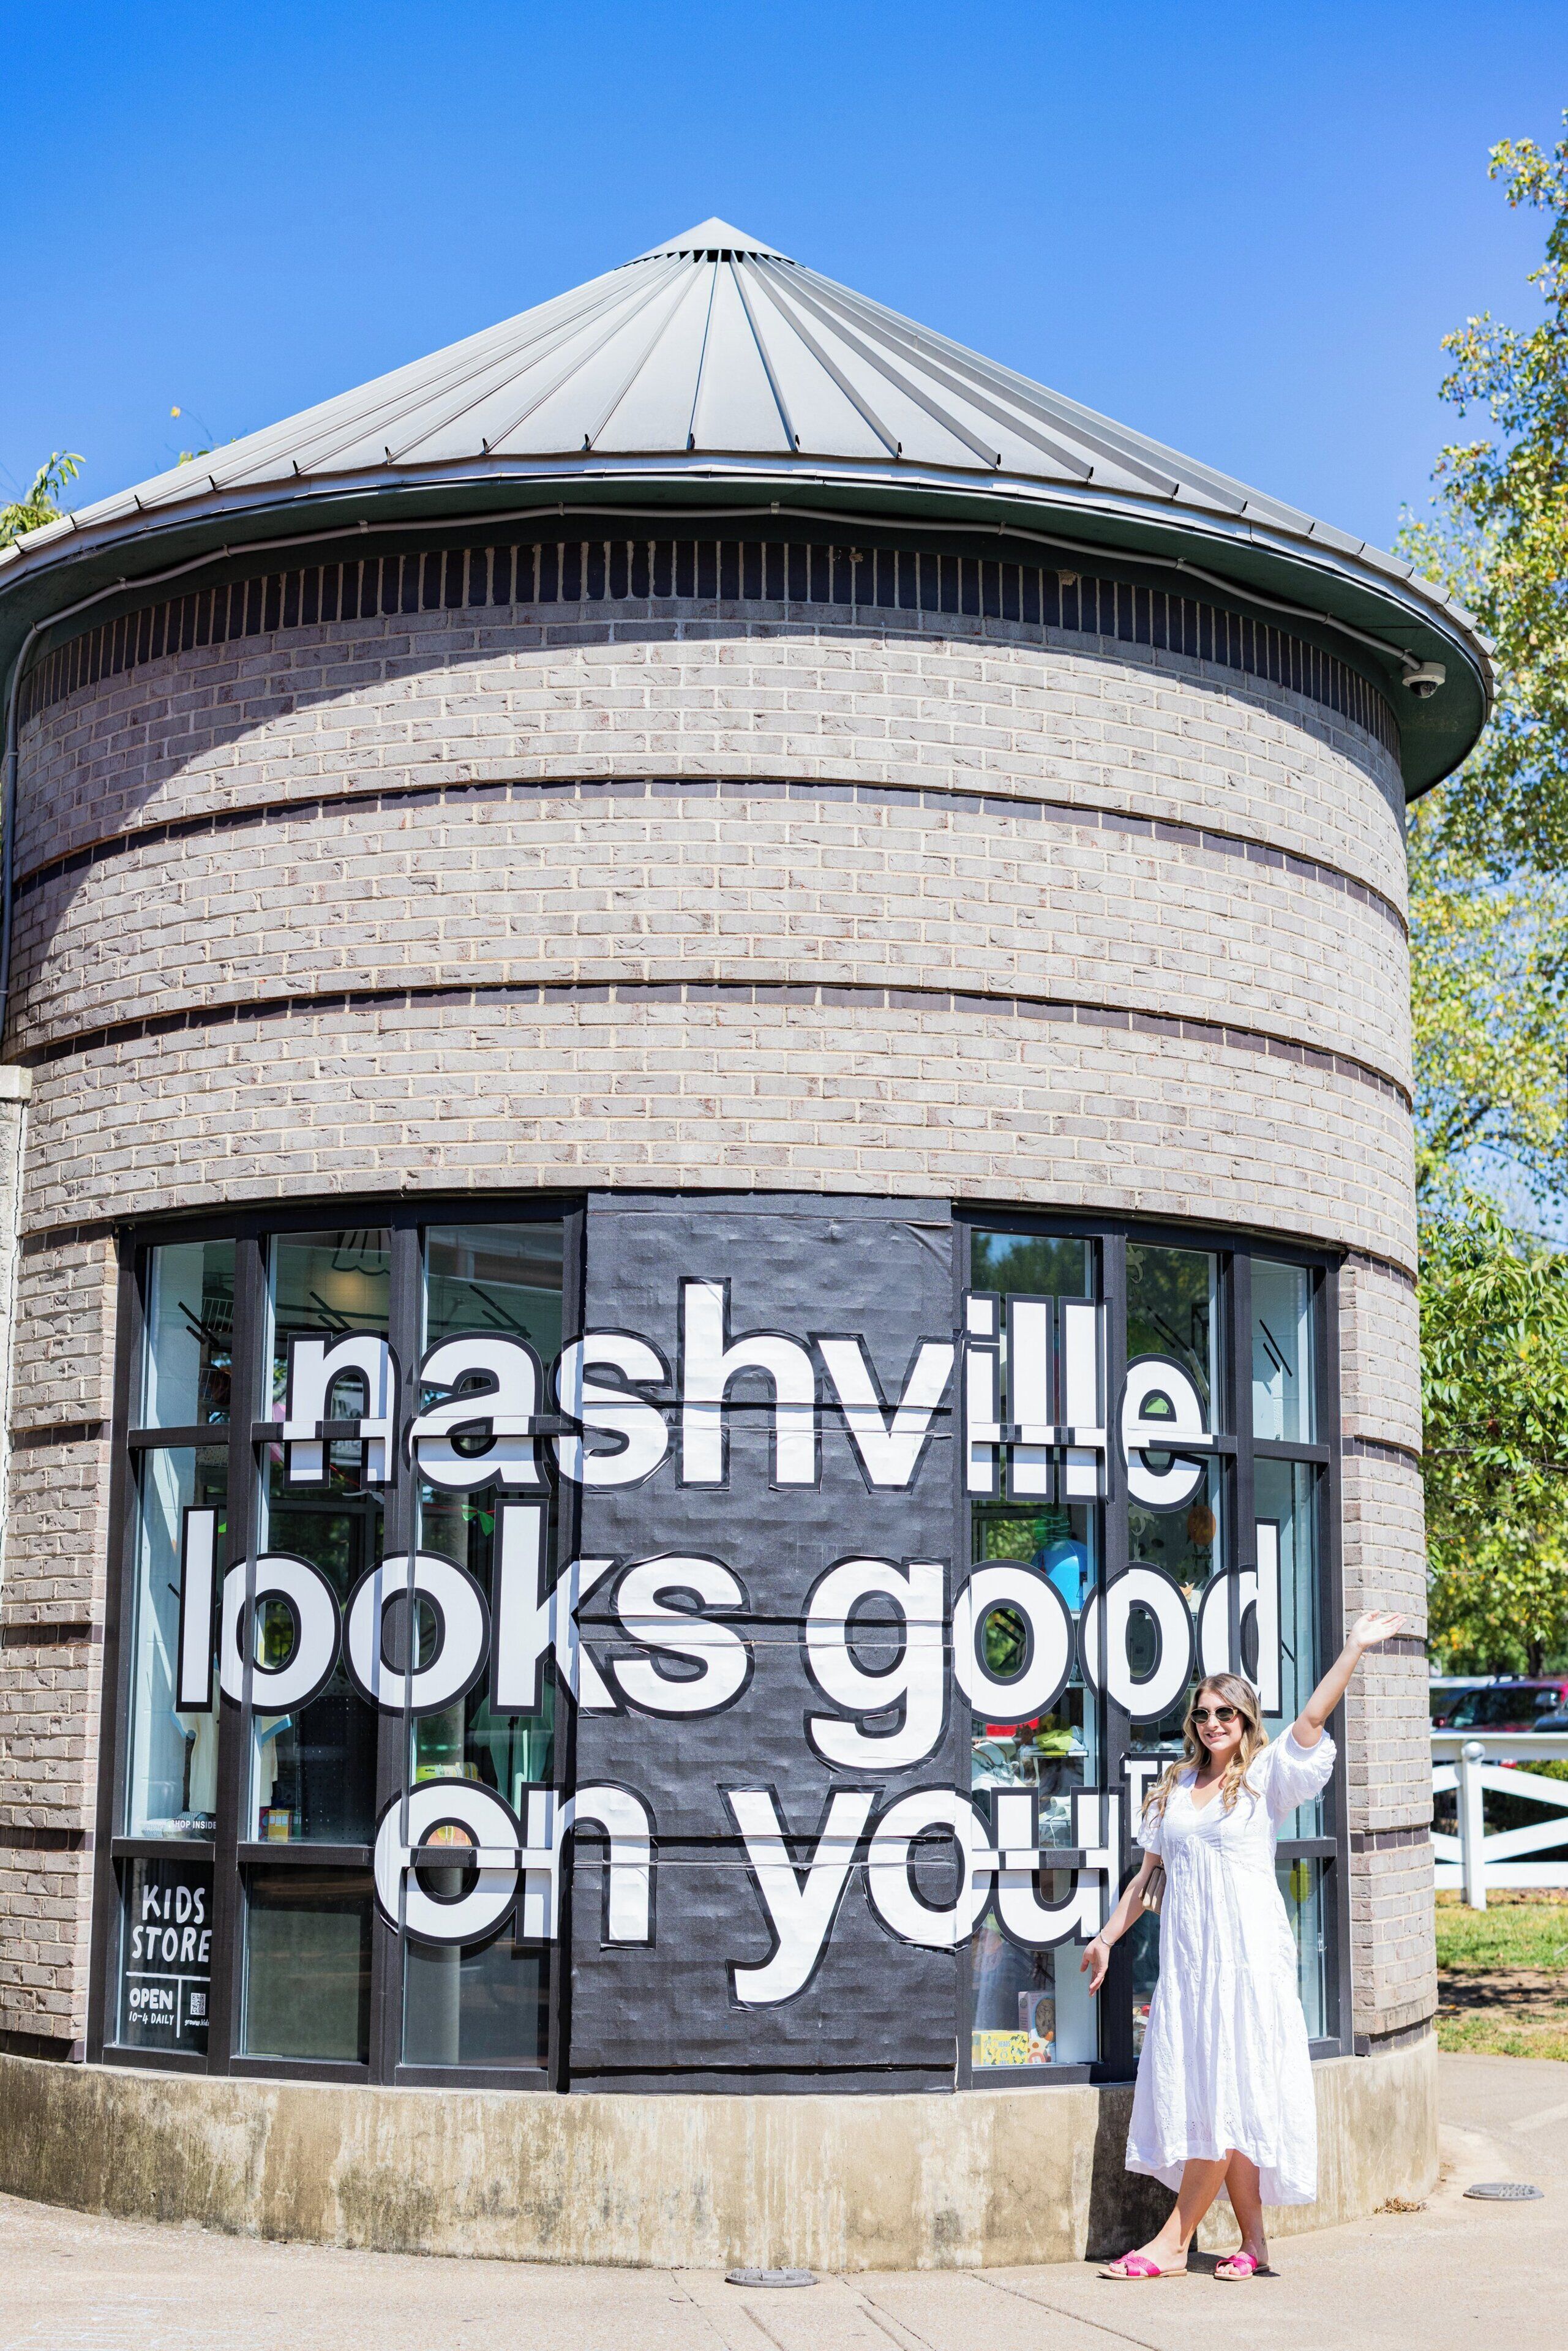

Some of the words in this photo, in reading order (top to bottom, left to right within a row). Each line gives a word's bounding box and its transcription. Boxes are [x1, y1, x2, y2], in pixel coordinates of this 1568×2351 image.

[282, 1283, 1214, 1505] nashville
[182, 1505, 748, 1711] looks
[805, 1524, 1278, 1769] good
[193, 1821, 216, 1829] INSIDE
[374, 1785, 650, 1940] on
[728, 1789, 1119, 2001] you
[1125, 1760, 1174, 1838] T
[142, 1884, 205, 1924] KIDS
[132, 1925, 212, 1963] STORE
[129, 1987, 173, 2010] OPEN
[129, 2011, 148, 2025] 10-4
[151, 2012, 174, 2025] DAILY
